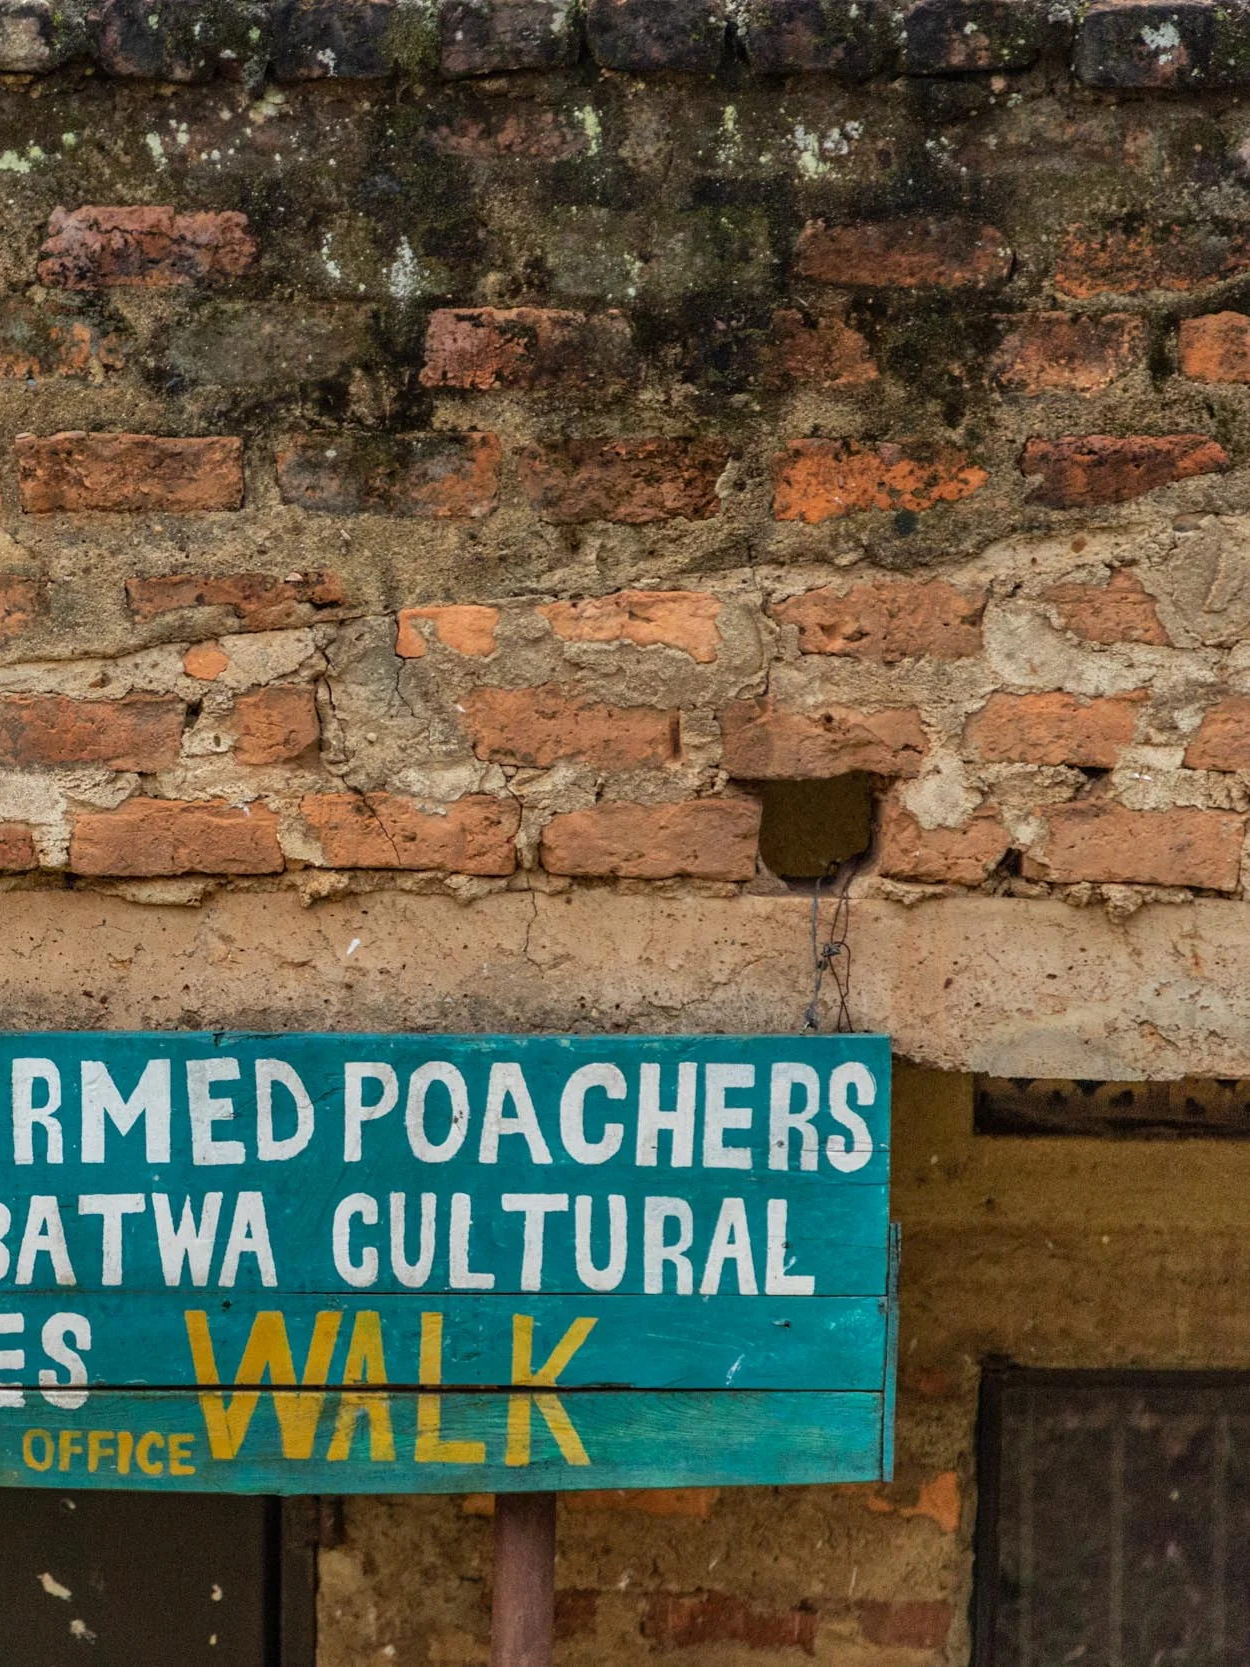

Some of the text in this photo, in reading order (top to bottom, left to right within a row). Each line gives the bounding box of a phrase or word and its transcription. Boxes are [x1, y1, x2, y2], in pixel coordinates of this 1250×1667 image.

[343, 1060, 878, 1173] POACHERS
[332, 1191, 816, 1296] CULTURAL
[184, 1309, 599, 1467] WALK
[22, 1429, 197, 1476] OFFICE
